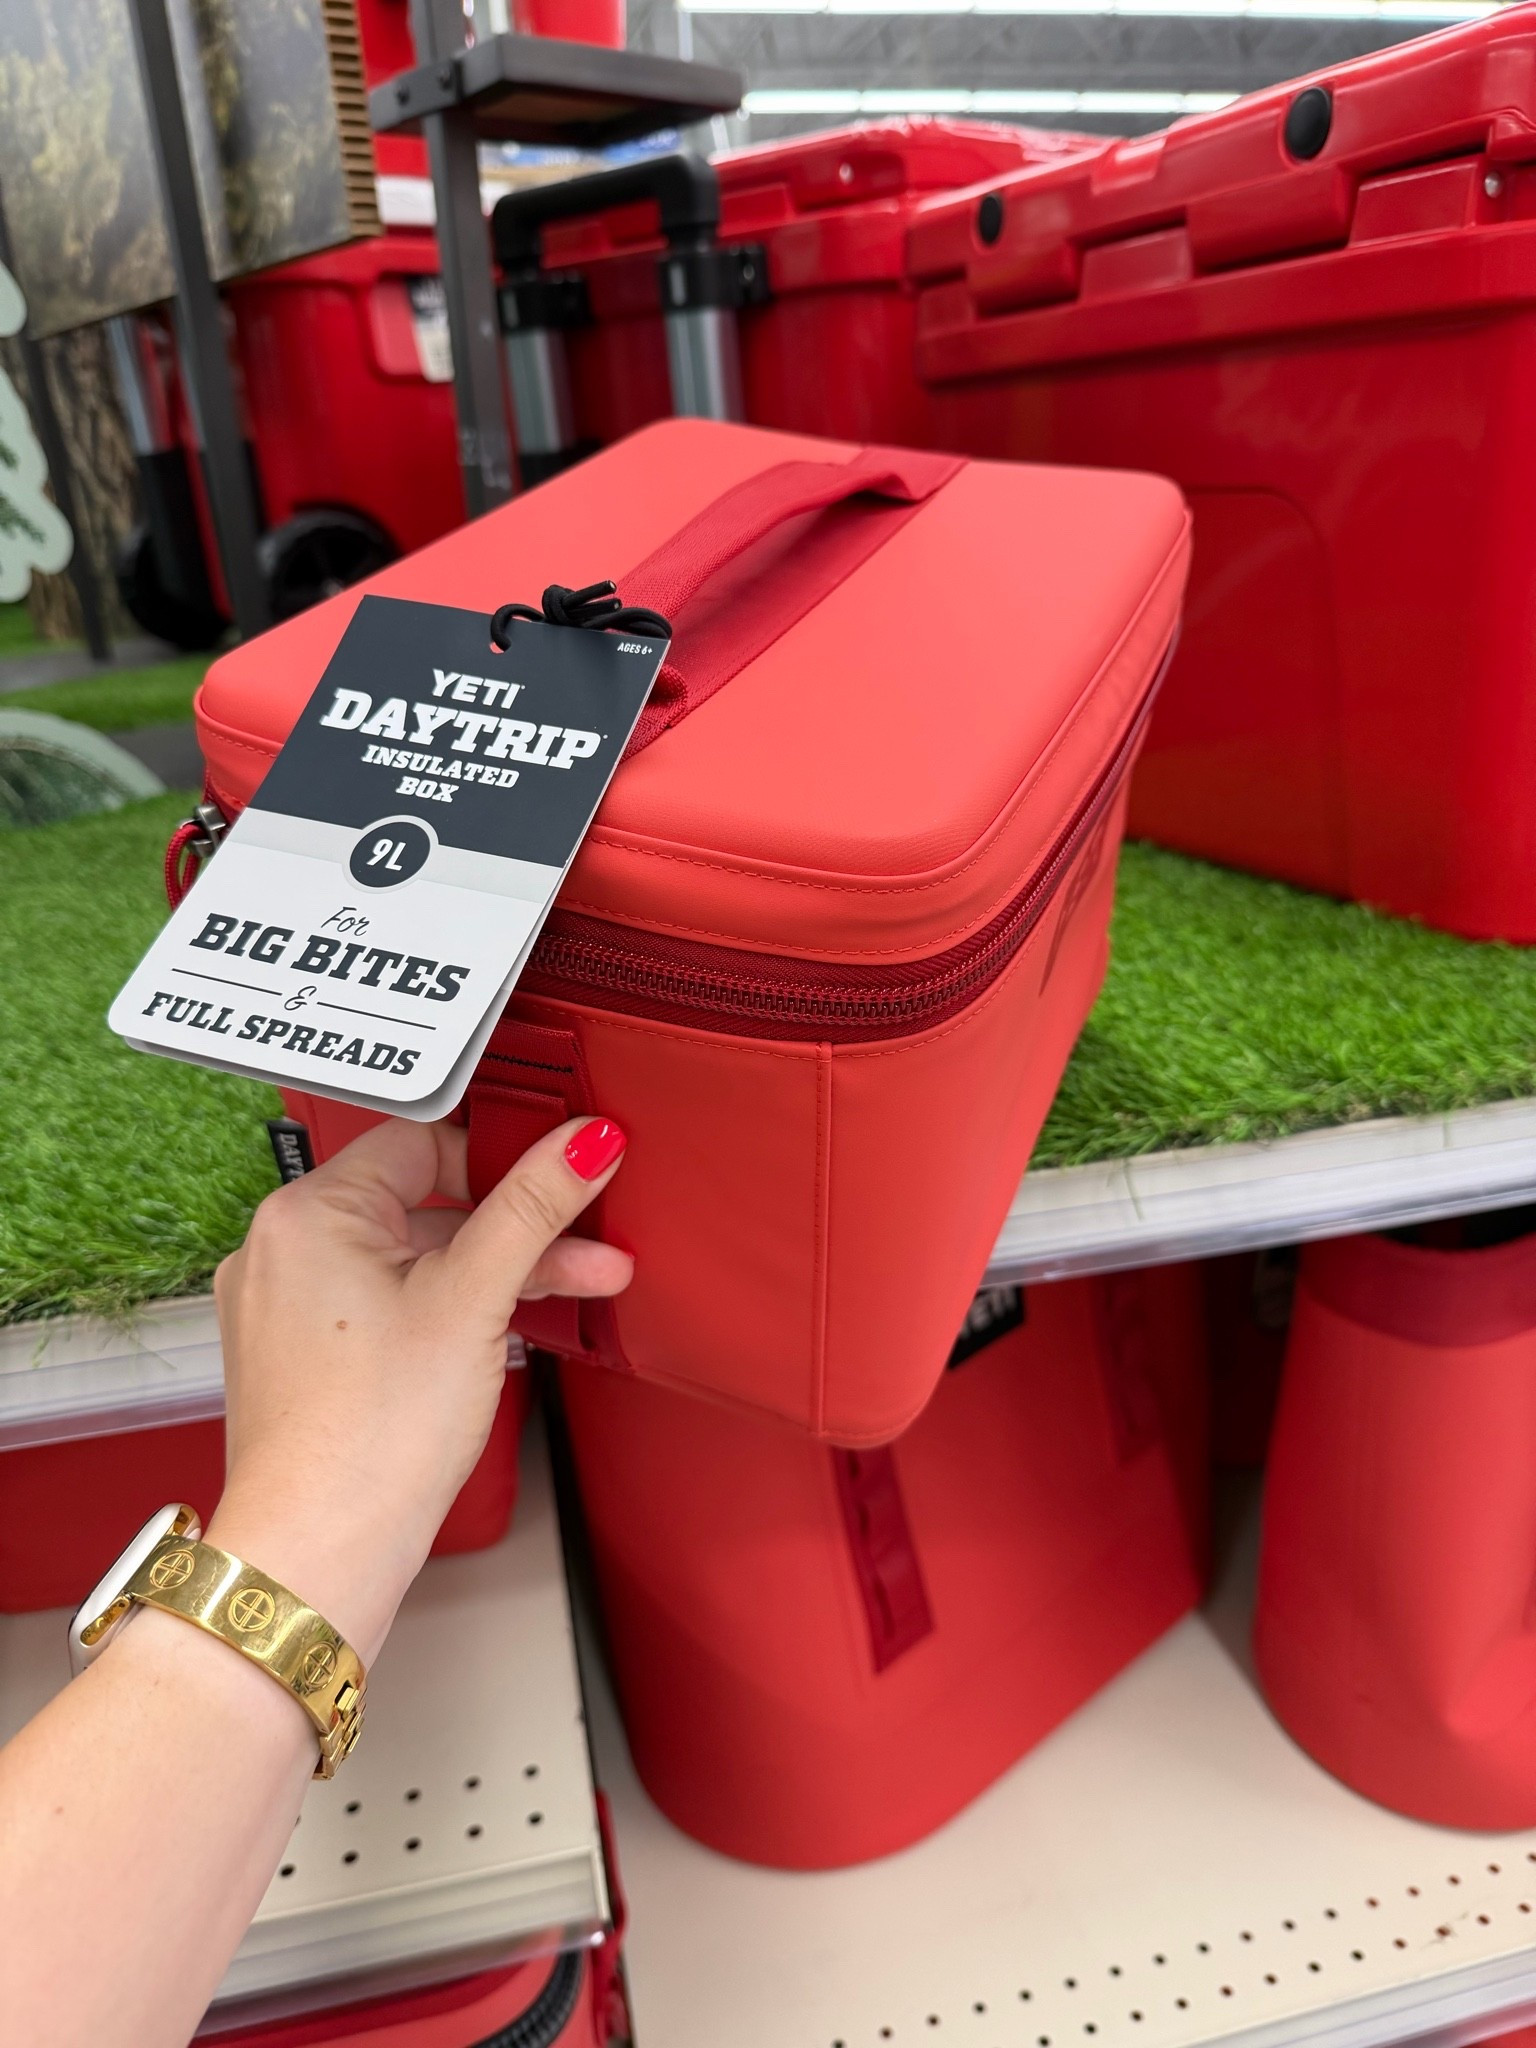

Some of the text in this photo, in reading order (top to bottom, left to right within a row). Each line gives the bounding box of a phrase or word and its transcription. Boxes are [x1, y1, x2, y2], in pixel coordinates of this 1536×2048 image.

[617, 641, 653, 655] AGES 6+
[431, 668, 521, 709] YETI
[319, 687, 601, 769] DAYTRIP
[361, 744, 520, 788] INSULATED
[396, 776, 459, 803] BOX
[366, 838, 407, 871] 9L
[321, 906, 371, 936] For
[189, 912, 471, 1002] BIG BITES
[284, 985, 318, 1011] &
[141, 991, 422, 1076] FULL SPREADS
[279, 1132, 306, 1181] DAYT
